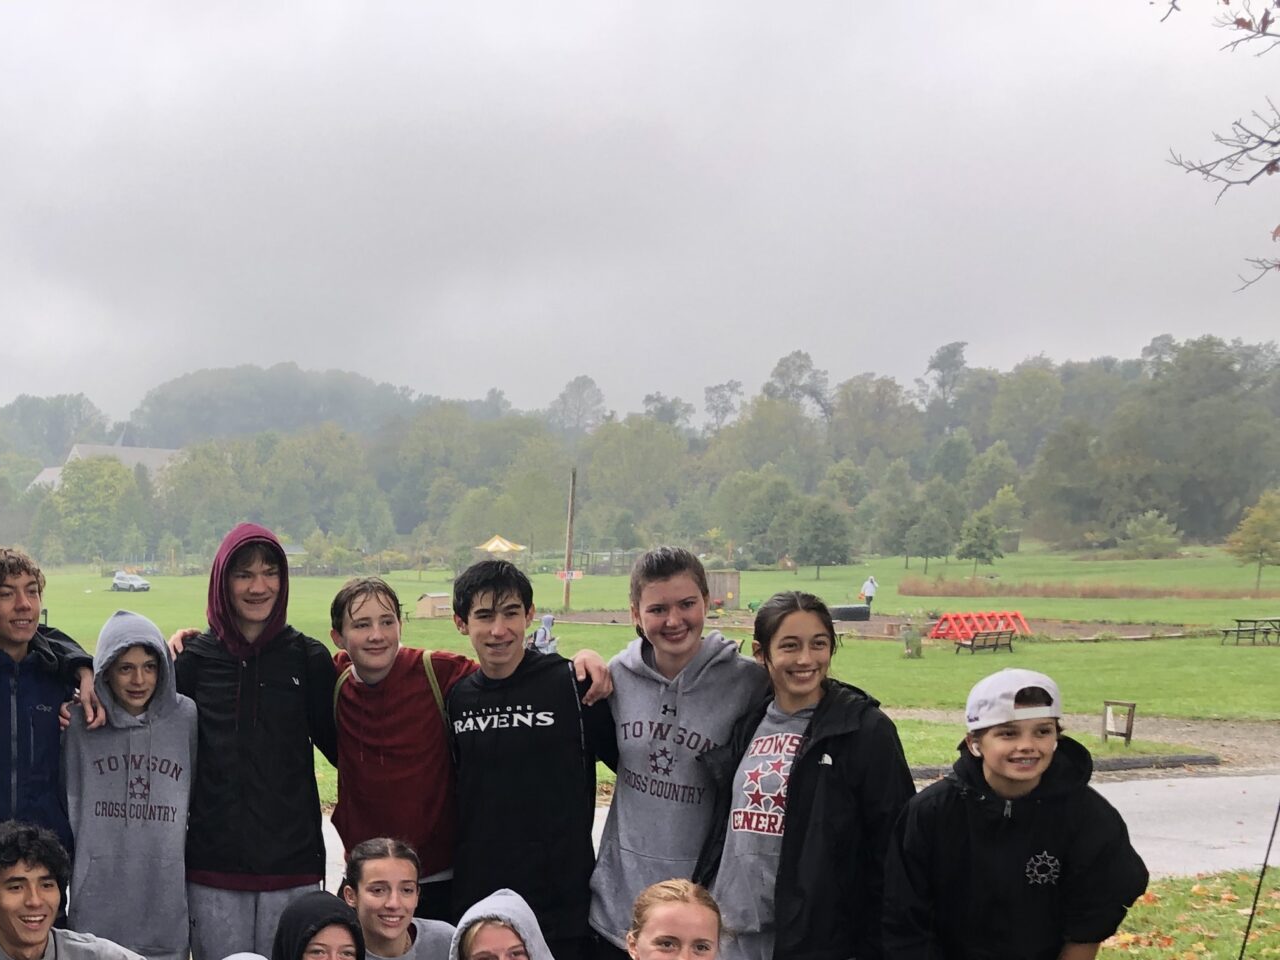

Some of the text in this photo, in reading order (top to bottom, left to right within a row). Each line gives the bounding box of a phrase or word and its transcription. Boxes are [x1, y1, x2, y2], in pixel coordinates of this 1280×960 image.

[453, 711, 555, 734] RAVENS
[93, 754, 183, 782] TOWSON
[650, 779, 705, 804] COUNTRY
[95, 801, 178, 822] CROSS COUNTRY
